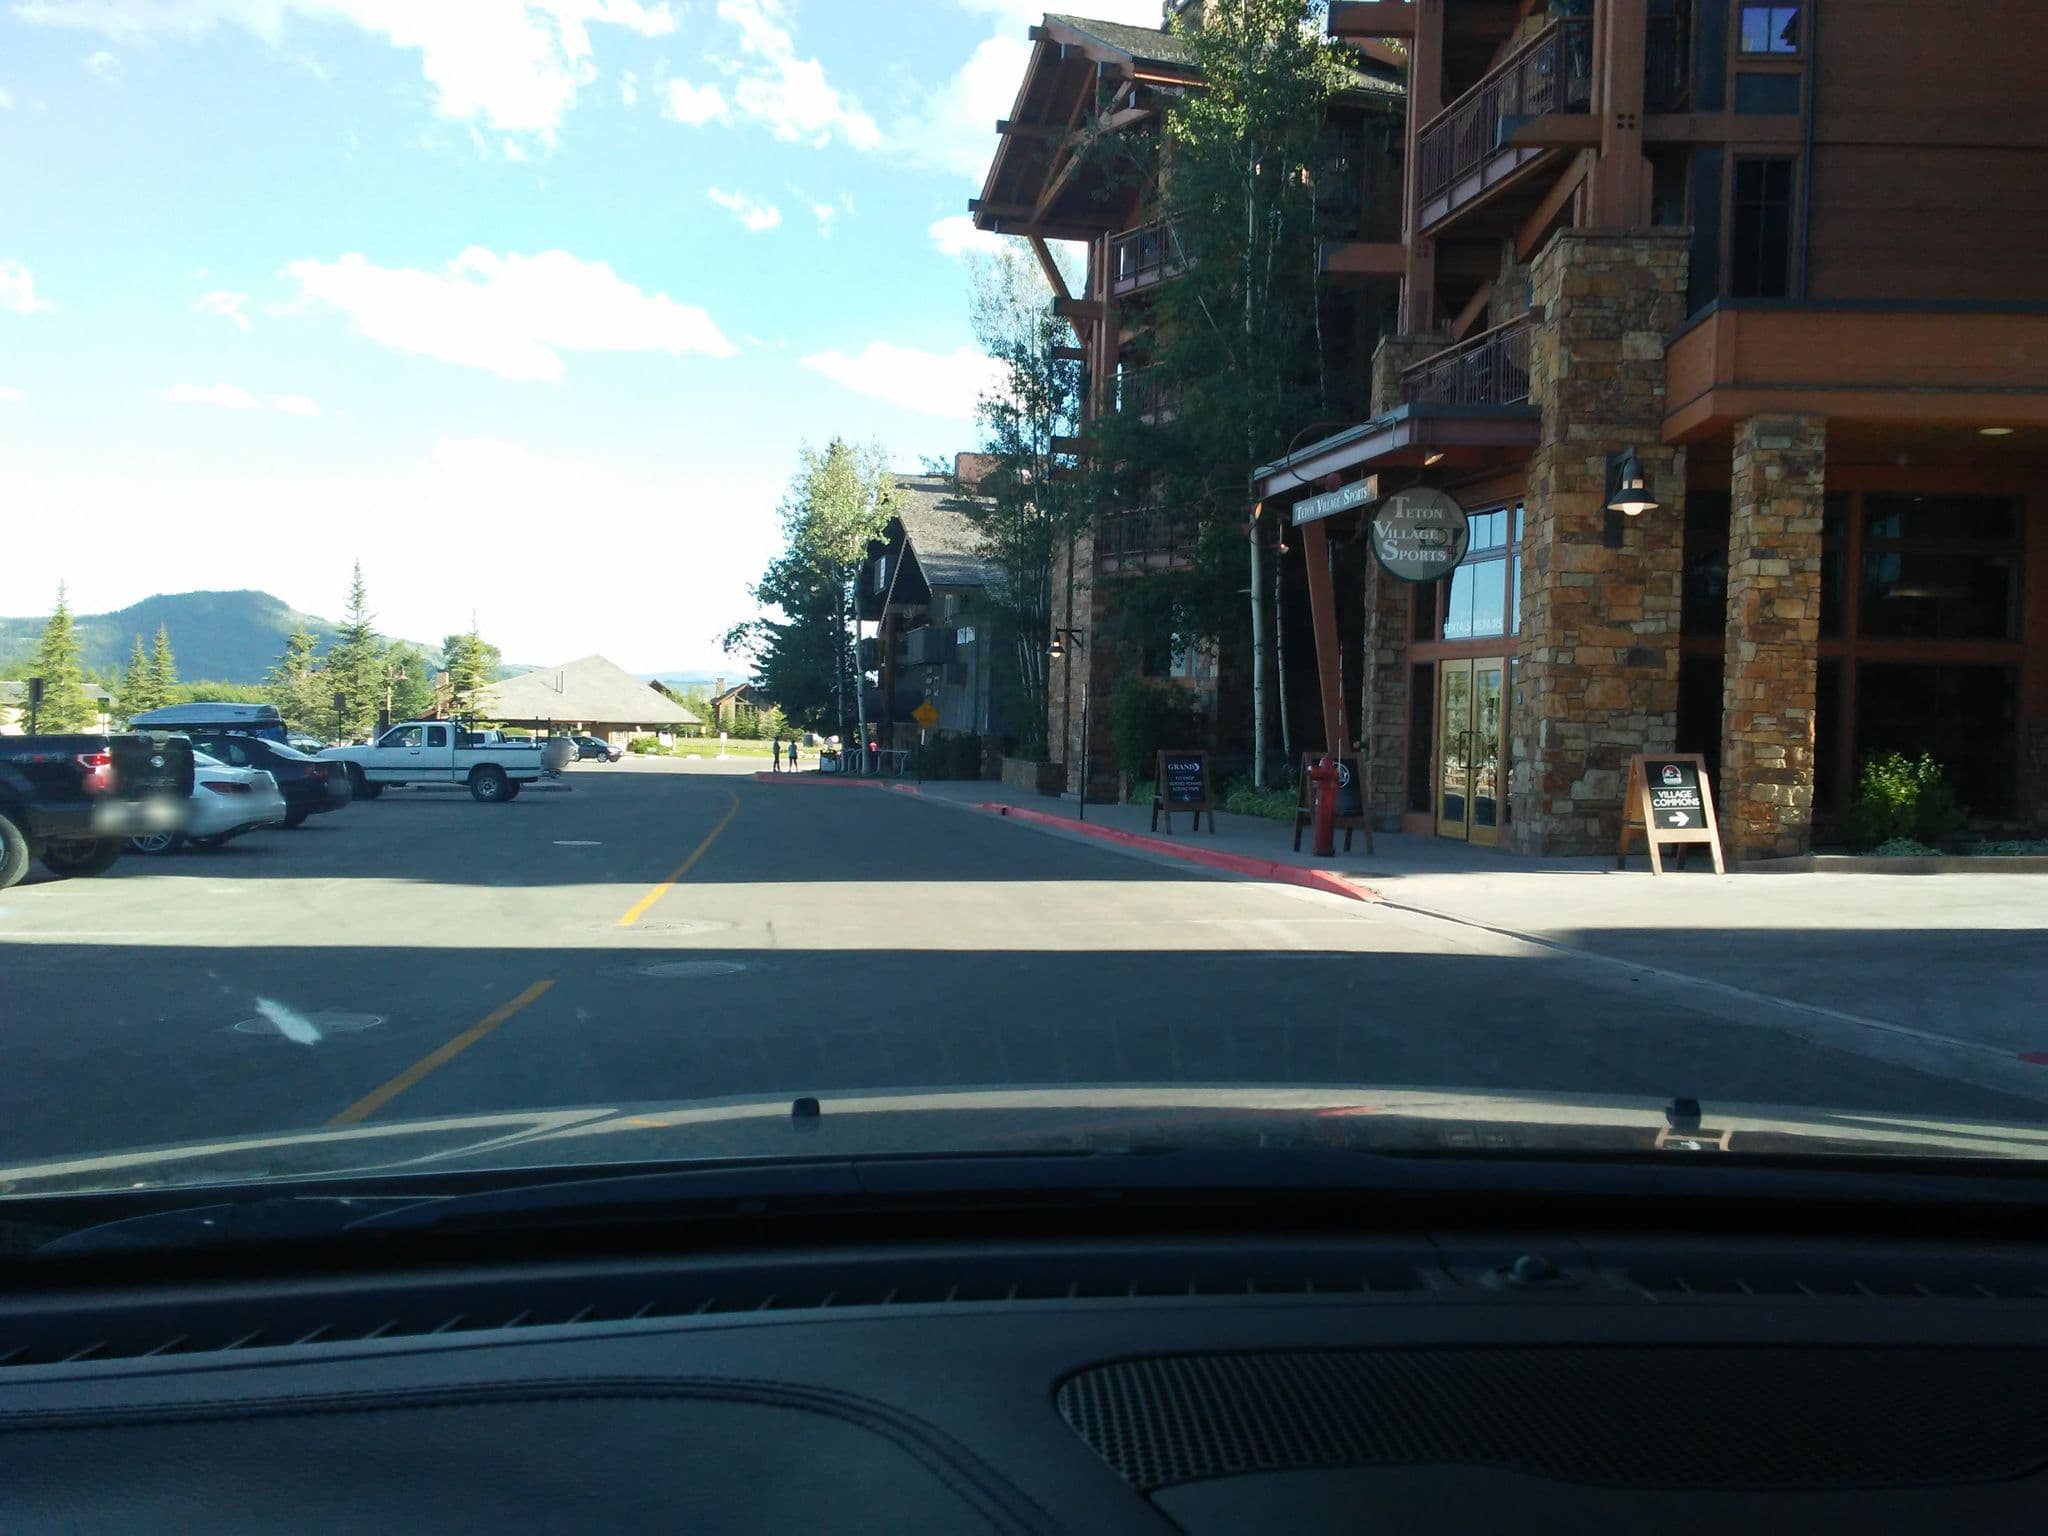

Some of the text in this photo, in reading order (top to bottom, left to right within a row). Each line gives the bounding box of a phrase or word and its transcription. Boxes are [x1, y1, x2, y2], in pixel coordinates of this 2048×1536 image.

[1317, 497, 1341, 514] VILLAGE
[1344, 486, 1368, 505] SPORTS
[1390, 496, 1443, 519] TETON
[1372, 520, 1438, 539] VILLAGE
[1381, 539, 1447, 561] SPORTS
[1168, 763, 1195, 771] GRAND
[1653, 798, 1700, 807] COMMONS
[1657, 790, 1693, 799] VILLAGE
